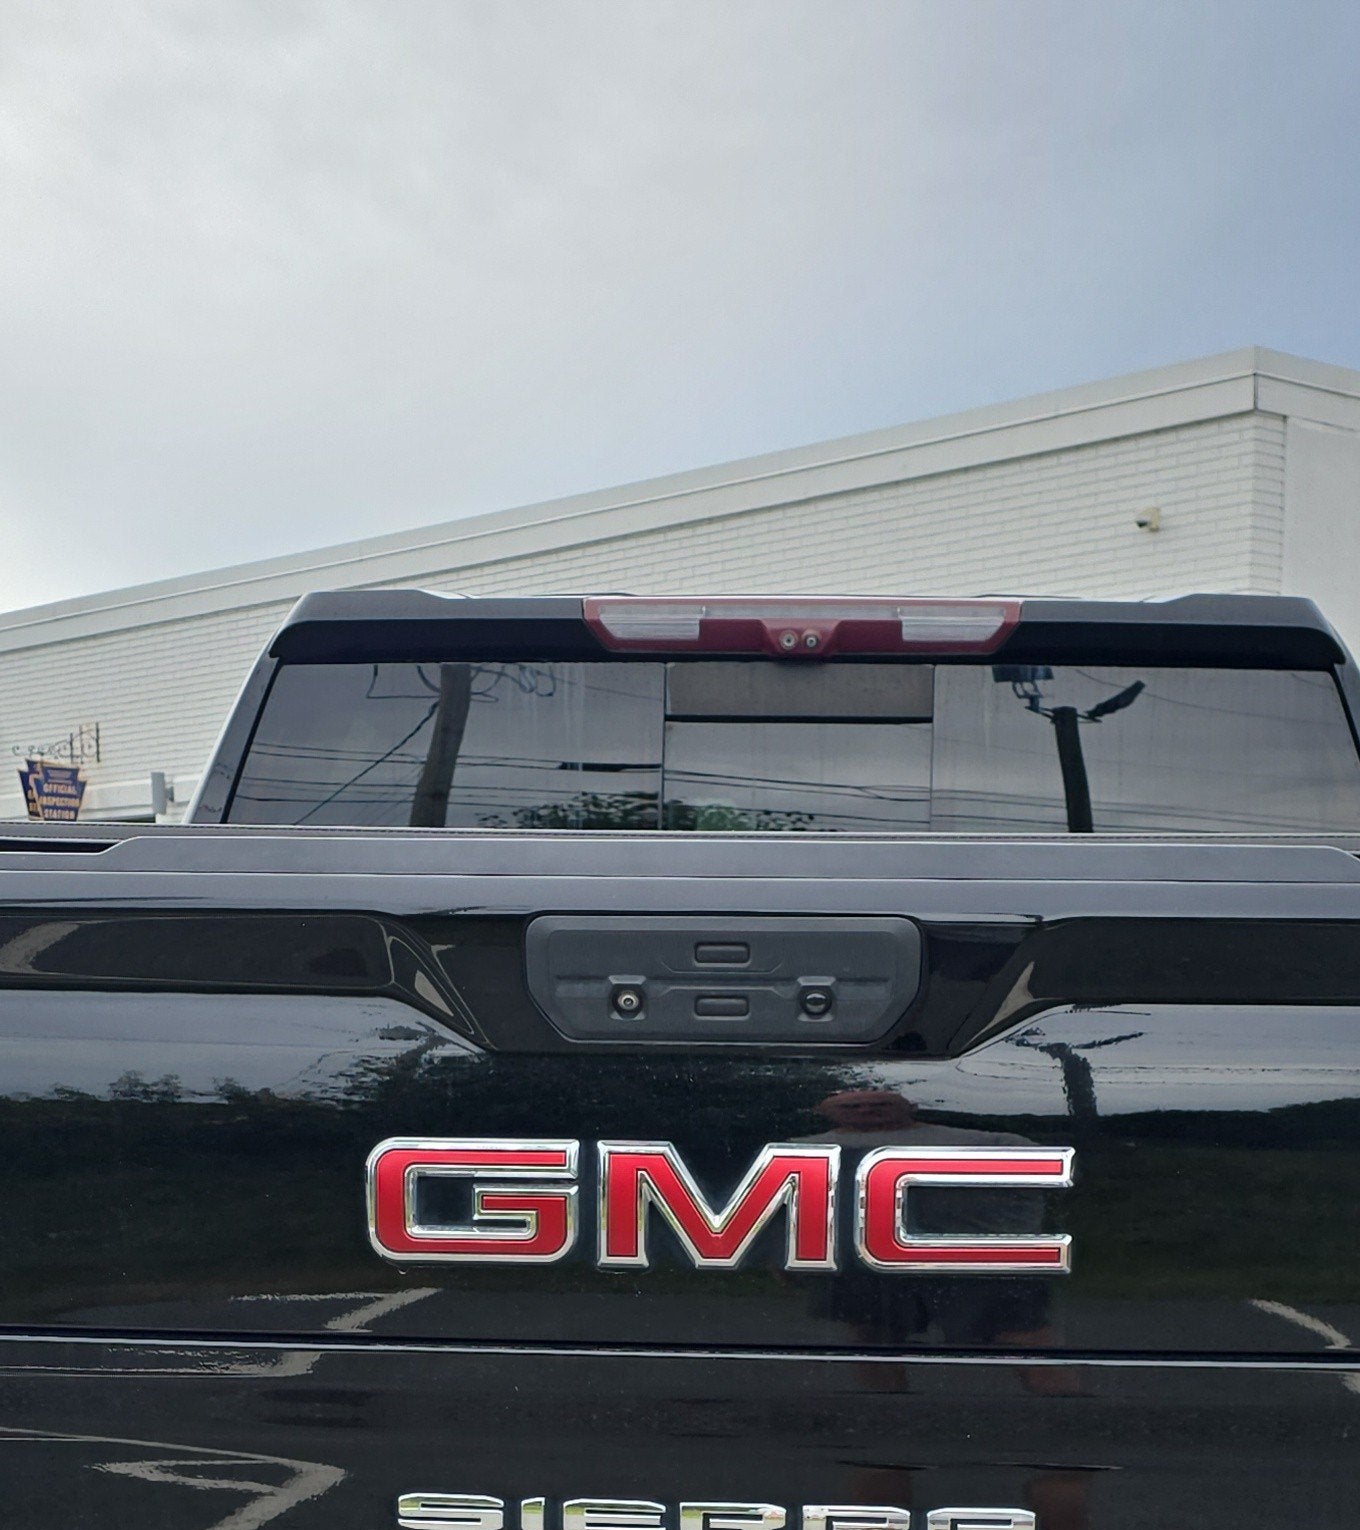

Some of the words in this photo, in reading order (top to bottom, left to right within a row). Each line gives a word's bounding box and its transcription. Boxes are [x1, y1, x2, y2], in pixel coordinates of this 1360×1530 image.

[43, 783, 77, 794] OFFICIAL
[43, 809, 76, 819] STATION
[366, 1136, 1076, 1275] GMC
